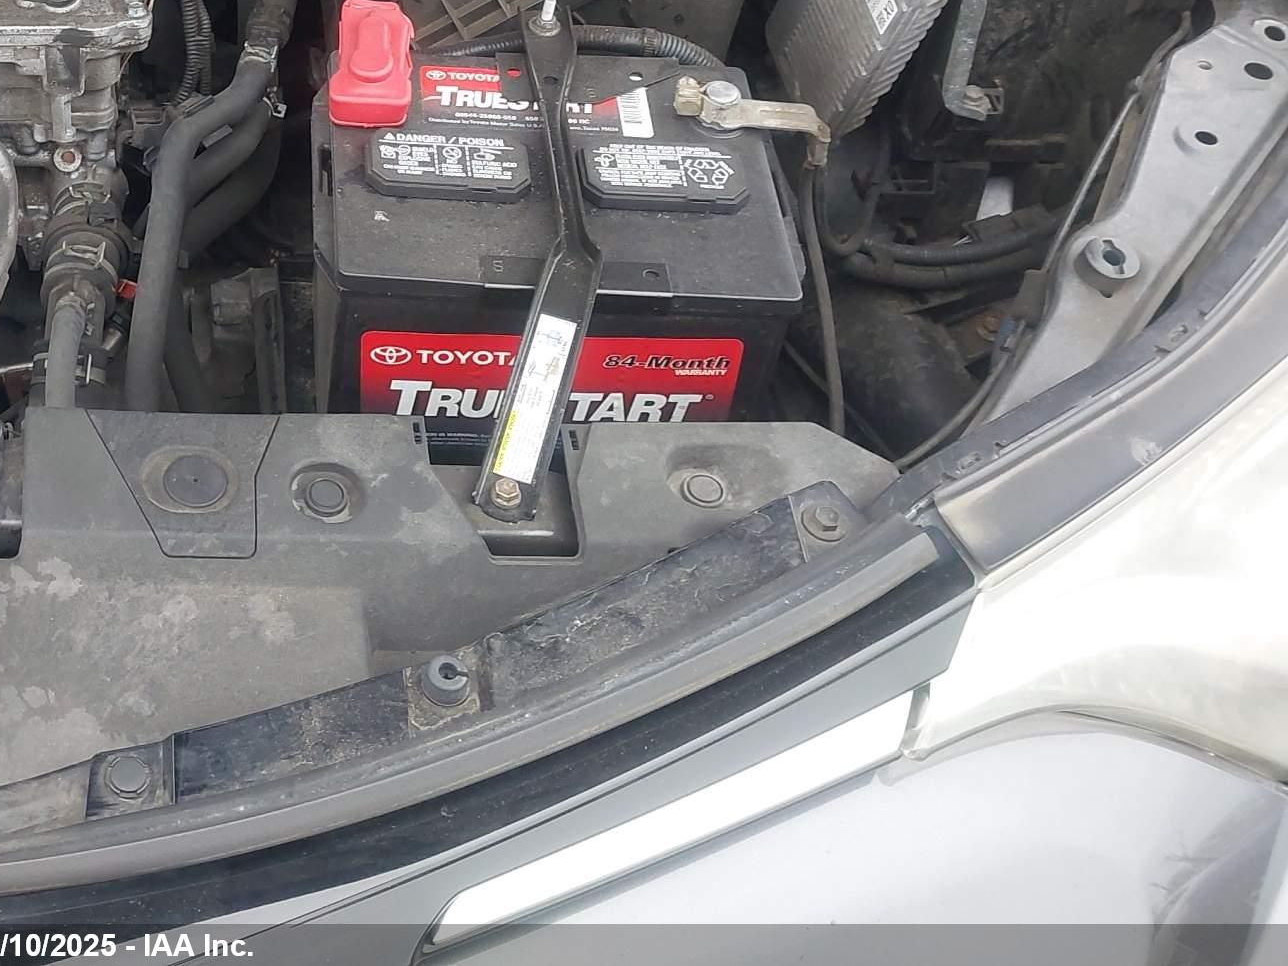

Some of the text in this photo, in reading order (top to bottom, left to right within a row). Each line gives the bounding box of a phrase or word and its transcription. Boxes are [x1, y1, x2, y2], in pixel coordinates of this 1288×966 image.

[396, 132, 447, 144] DANGER
[458, 137, 505, 147] POISON
[416, 349, 731, 370] TOYOT 84-Month
